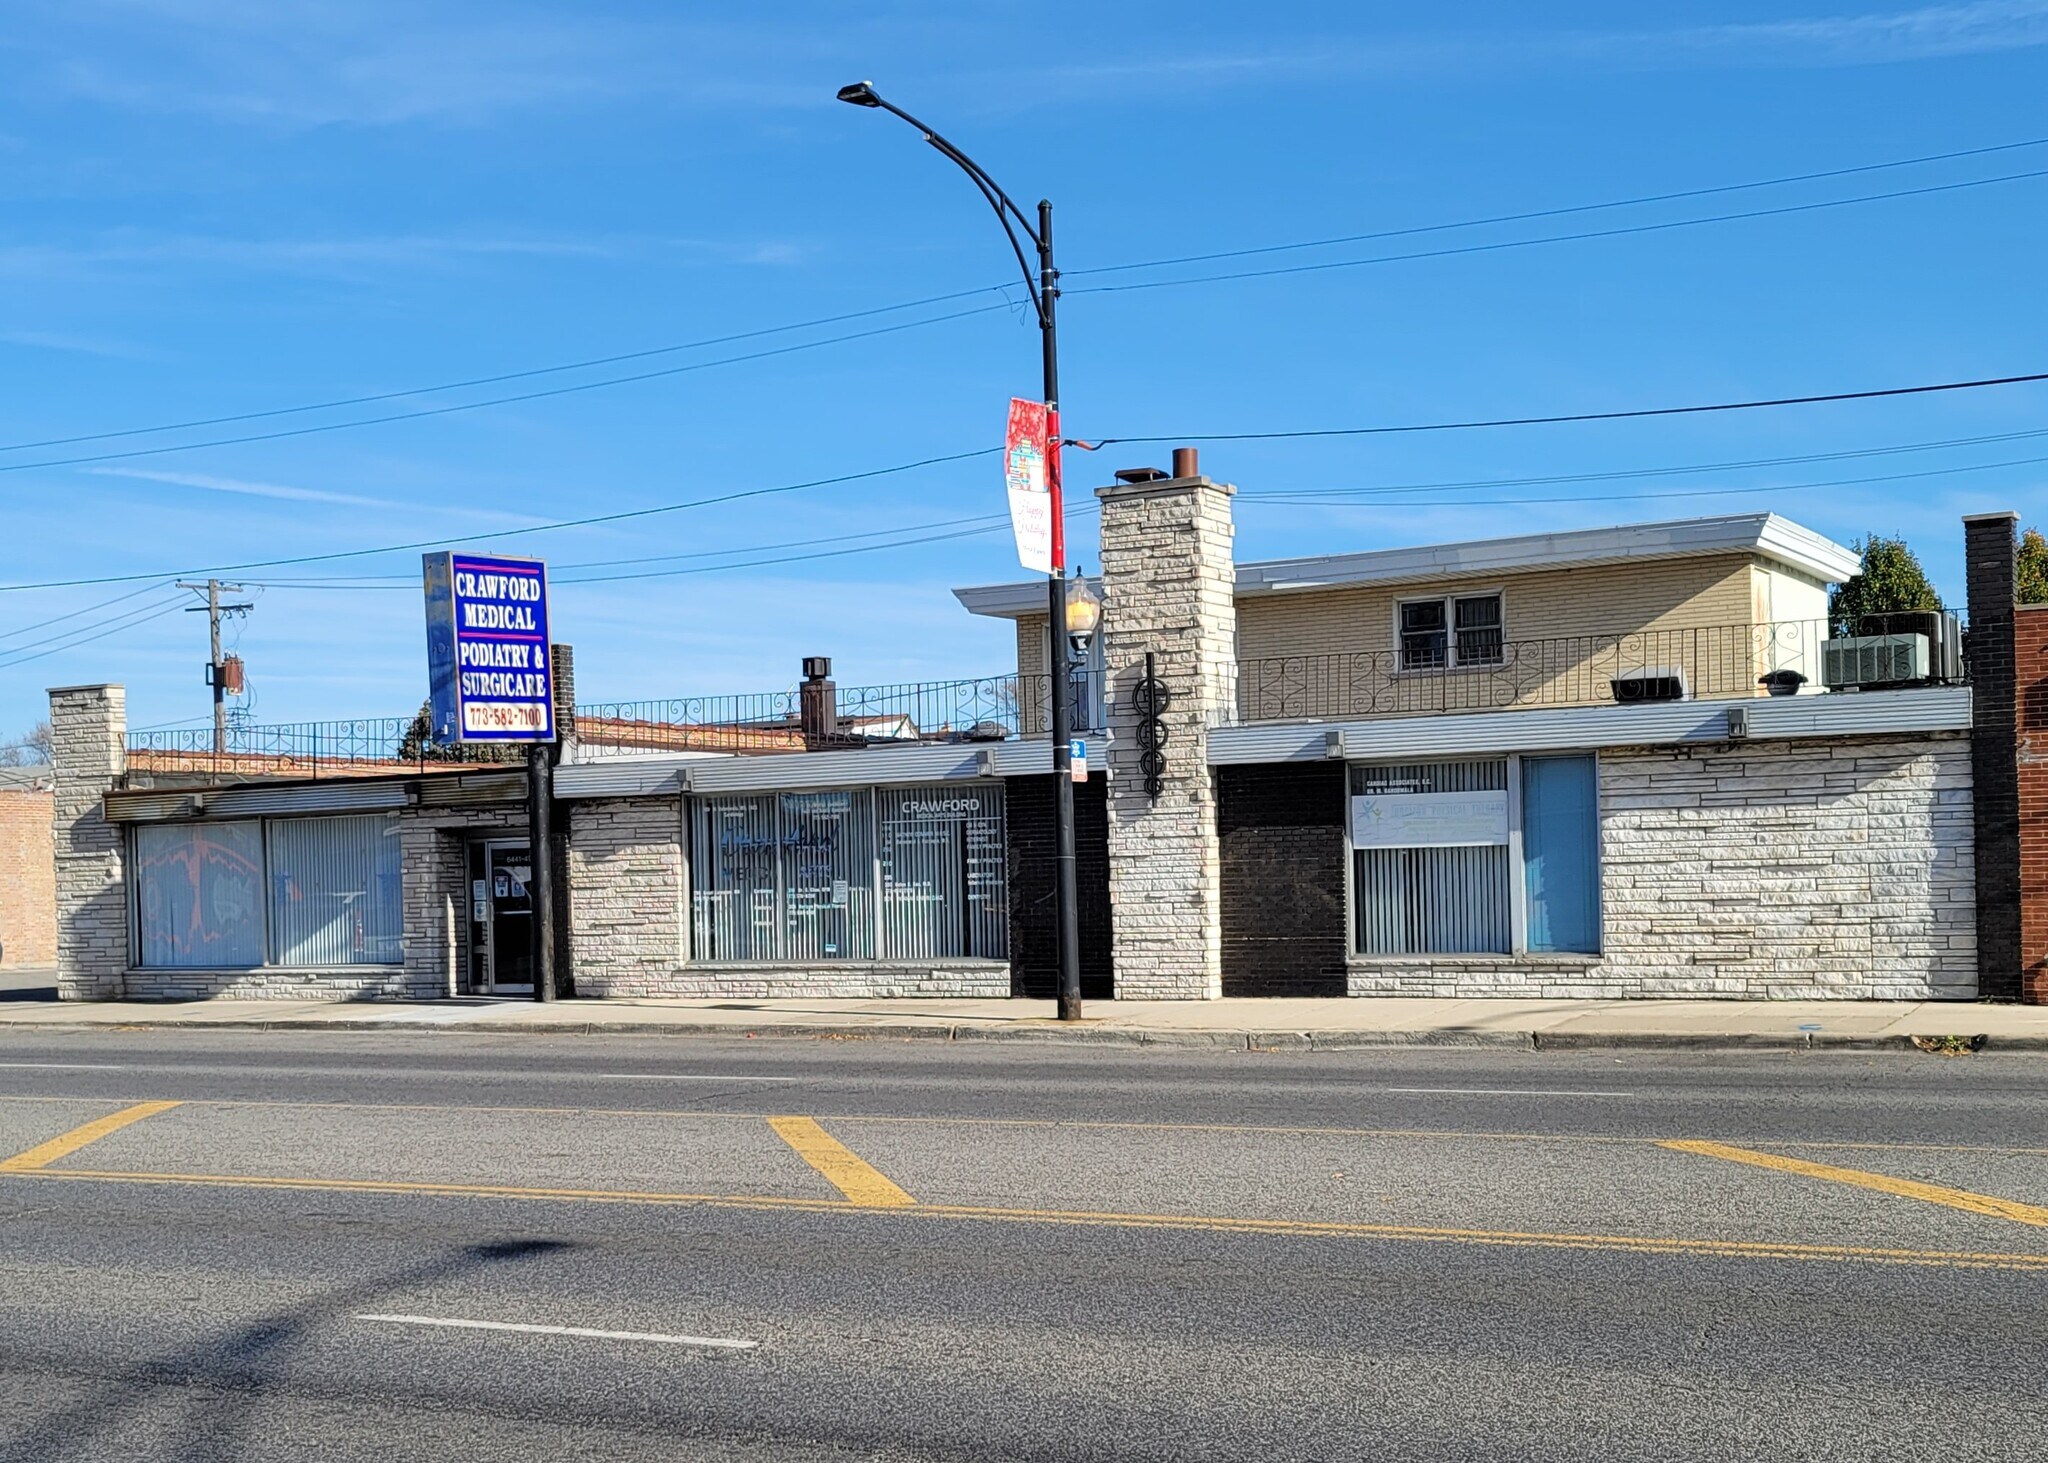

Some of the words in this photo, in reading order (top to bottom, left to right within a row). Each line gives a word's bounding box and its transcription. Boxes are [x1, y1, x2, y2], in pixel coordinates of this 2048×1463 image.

[456, 573, 540, 601] CRAWFORD
[464, 603, 536, 630] MEDICAL
[460, 642, 530, 668] PODIATRY
[534, 645, 544, 669] &
[462, 672, 546, 697] SURGICARE
[470, 708, 541, 726] 773-582-7100
[902, 799, 979, 813] CRAWFORD
